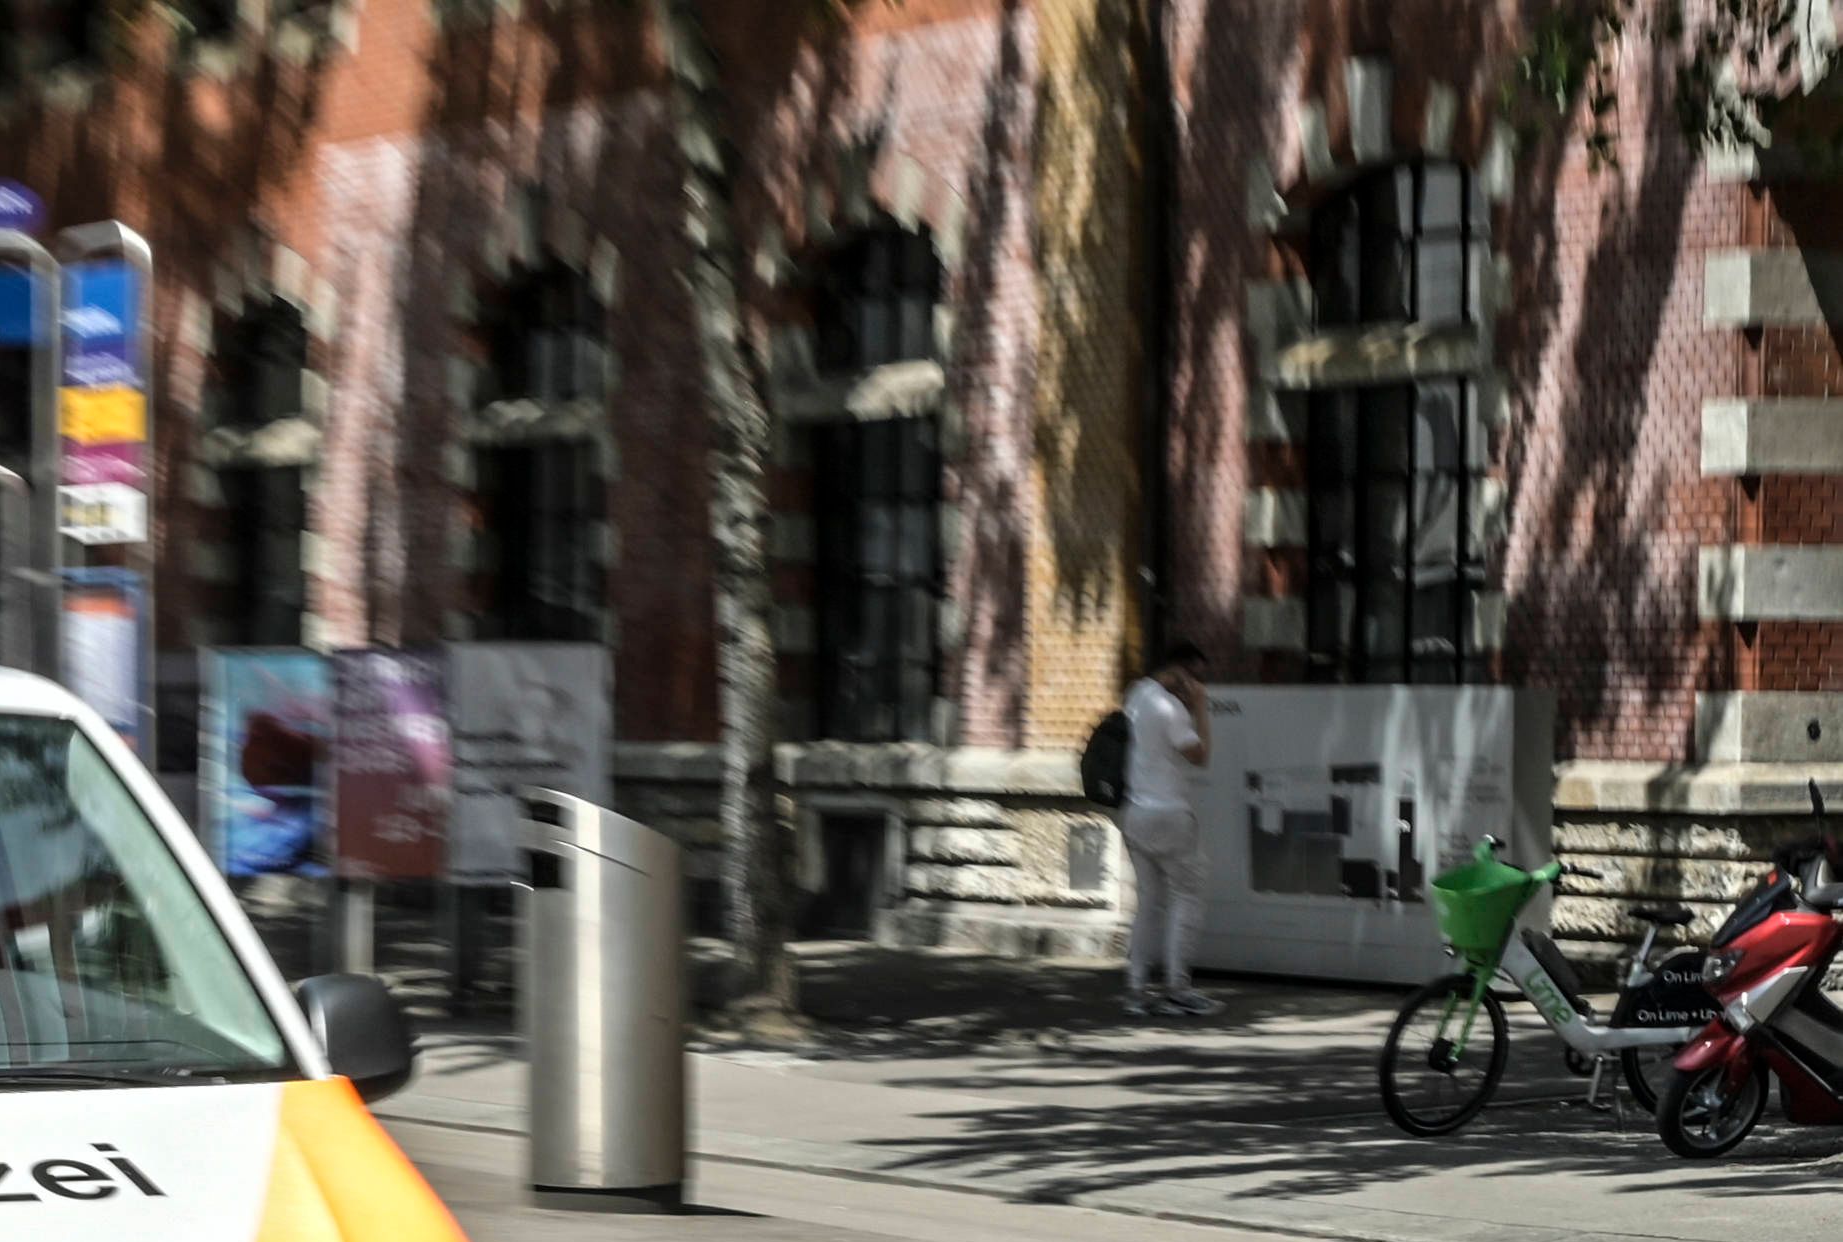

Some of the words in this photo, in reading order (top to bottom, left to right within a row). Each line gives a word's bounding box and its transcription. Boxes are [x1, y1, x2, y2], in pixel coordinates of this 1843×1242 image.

[1663, 970, 1682, 985] On
[1637, 1009, 1657, 1024] On
[1659, 1009, 1689, 1023] Lime
